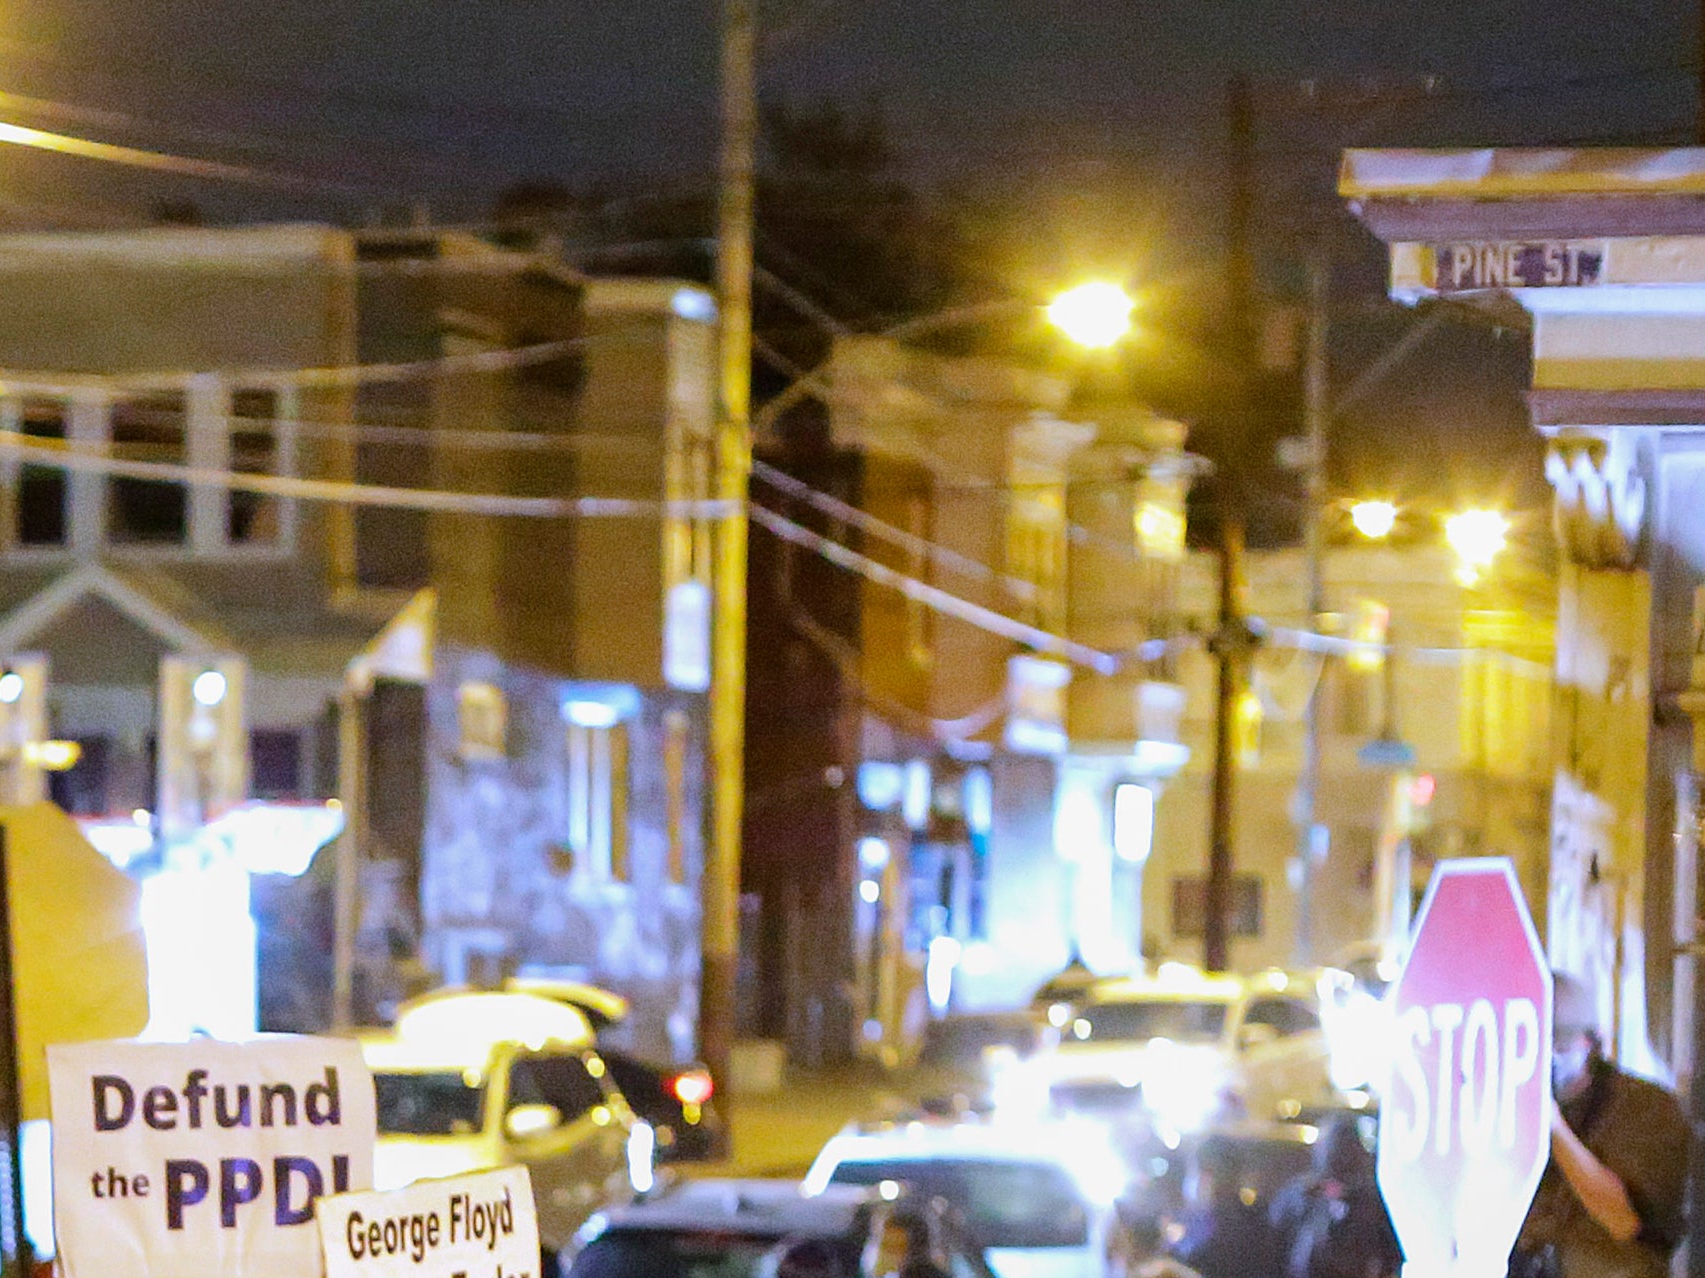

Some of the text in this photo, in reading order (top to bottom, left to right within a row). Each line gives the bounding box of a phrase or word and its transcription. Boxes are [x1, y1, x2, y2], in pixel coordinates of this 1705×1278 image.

[1453, 243, 1526, 287] PINE
[91, 1066, 341, 1132] Defund
[1391, 998, 1539, 1163] STOP
[91, 1167, 150, 1198] the
[347, 1187, 513, 1262] George Floyd
